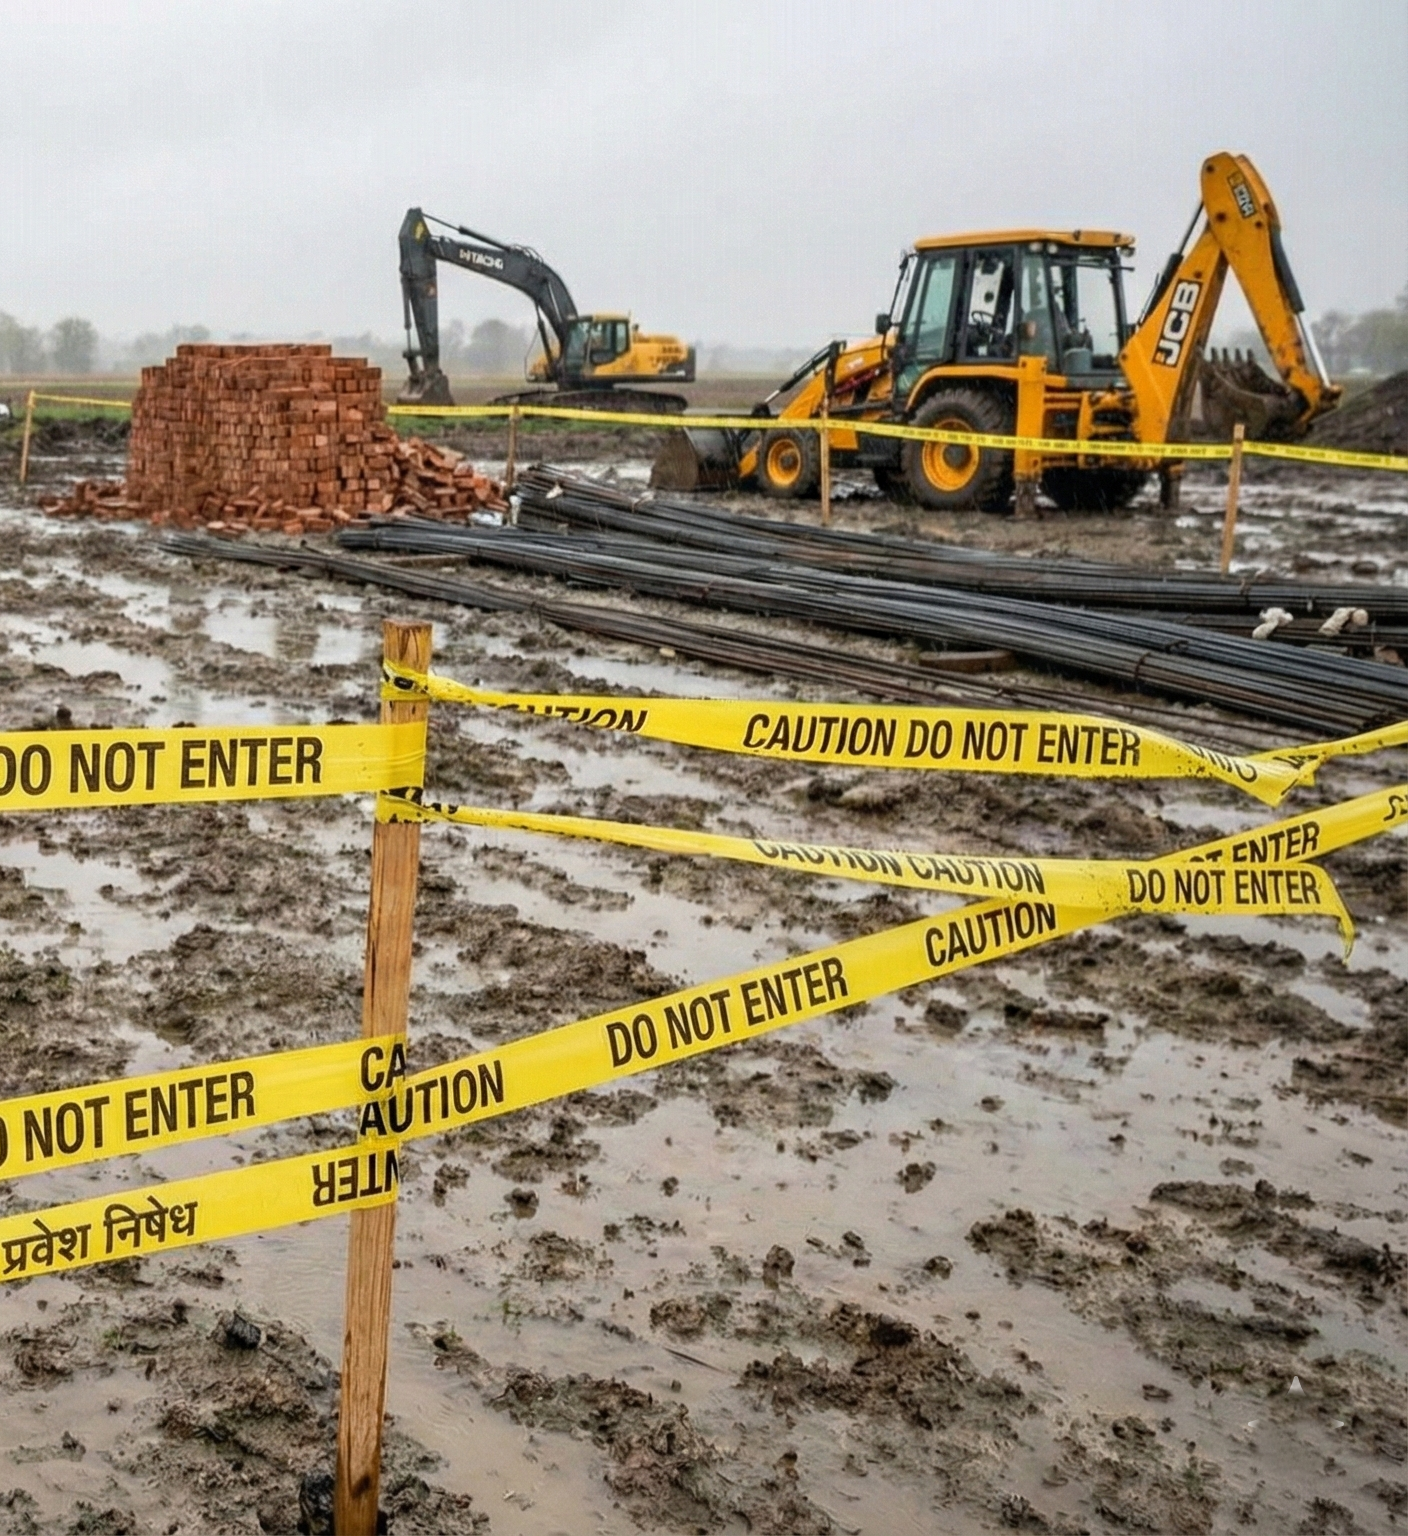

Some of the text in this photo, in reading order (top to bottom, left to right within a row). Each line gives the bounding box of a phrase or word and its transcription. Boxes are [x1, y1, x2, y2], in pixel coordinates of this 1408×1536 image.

[1156, 282, 1200, 366] JCB
[71, 742, 164, 792] NOT
[181, 738, 322, 788] ENTER
[744, 714, 896, 756] CAUTION
[905, 720, 952, 758] DO
[963, 722, 1028, 761] NOT
[1038, 724, 1142, 768] ENTER
[906, 855, 1046, 895] CAUTION
[1128, 870, 1165, 903] DO
[1175, 870, 1225, 905] NOT
[1235, 871, 1320, 904] ENTER
[606, 1013, 658, 1068] DO
[664, 990, 731, 1049] NOT
[740, 957, 849, 1026] ENTER
[926, 901, 1057, 966] CAUTION
[24, 1097, 109, 1161] NOT
[126, 1072, 254, 1140] ENTER
[1, 1219, 92, 1276] प्रवेश
[104, 1196, 197, 1253] निषेध
